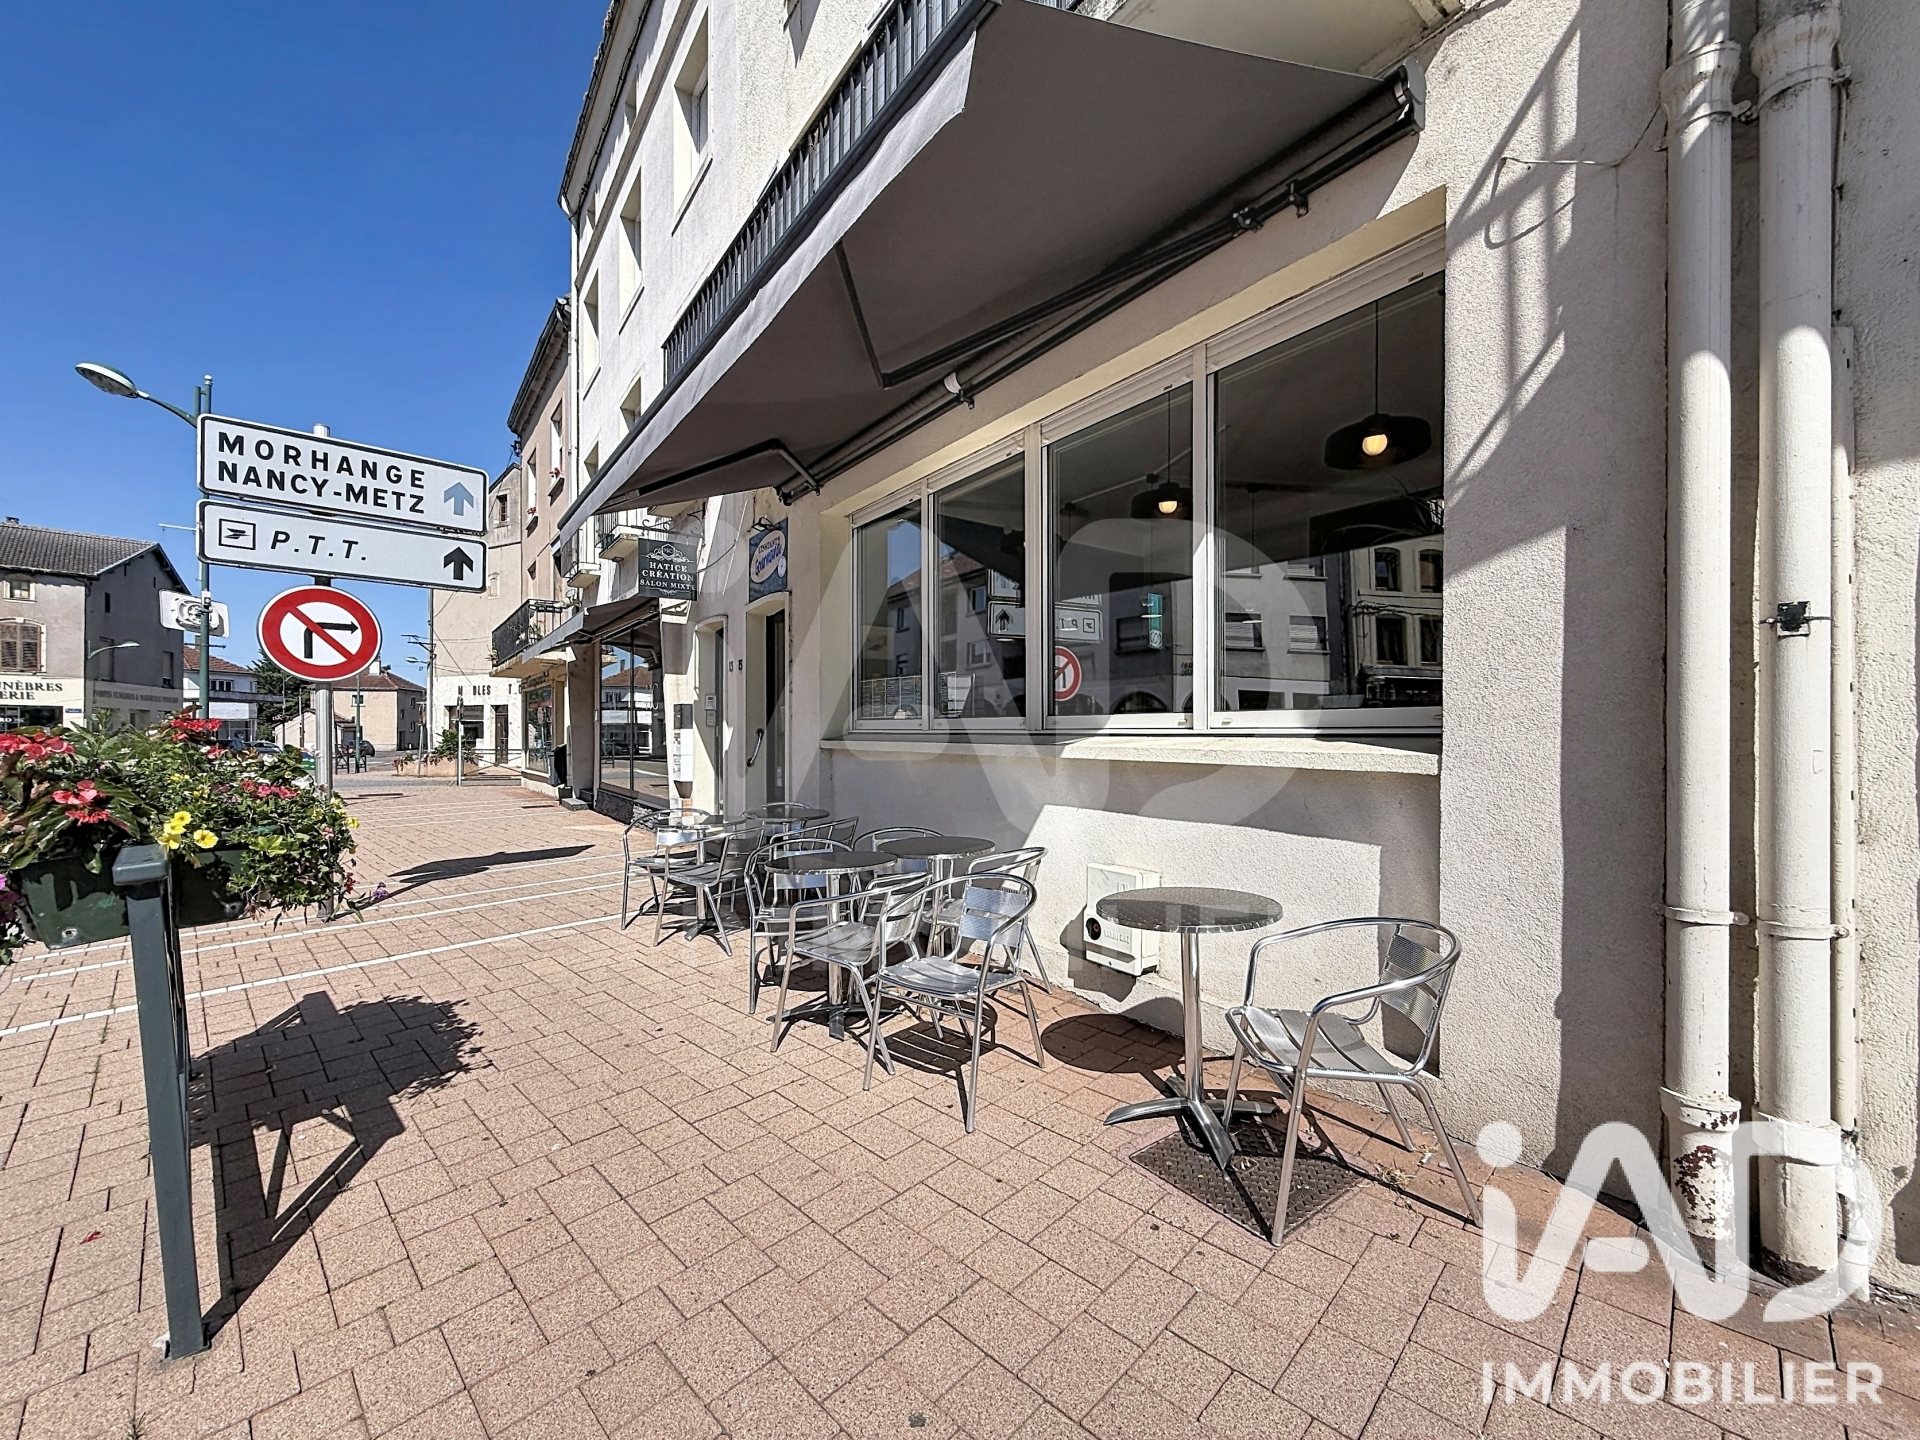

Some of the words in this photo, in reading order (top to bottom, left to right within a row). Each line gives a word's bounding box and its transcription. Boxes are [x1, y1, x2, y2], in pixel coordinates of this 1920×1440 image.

[218, 431, 425, 489] MORHANGE
[218, 460, 425, 514] NANCY-METZ
[270, 530, 367, 561] P.T.T.
[649, 561, 688, 573] HATICE
[641, 569, 694, 582] CRÉATION
[640, 579, 668, 588] SALON
[670, 582, 696, 591] MIXTE
[0, 680, 63, 692] NÈBRES
